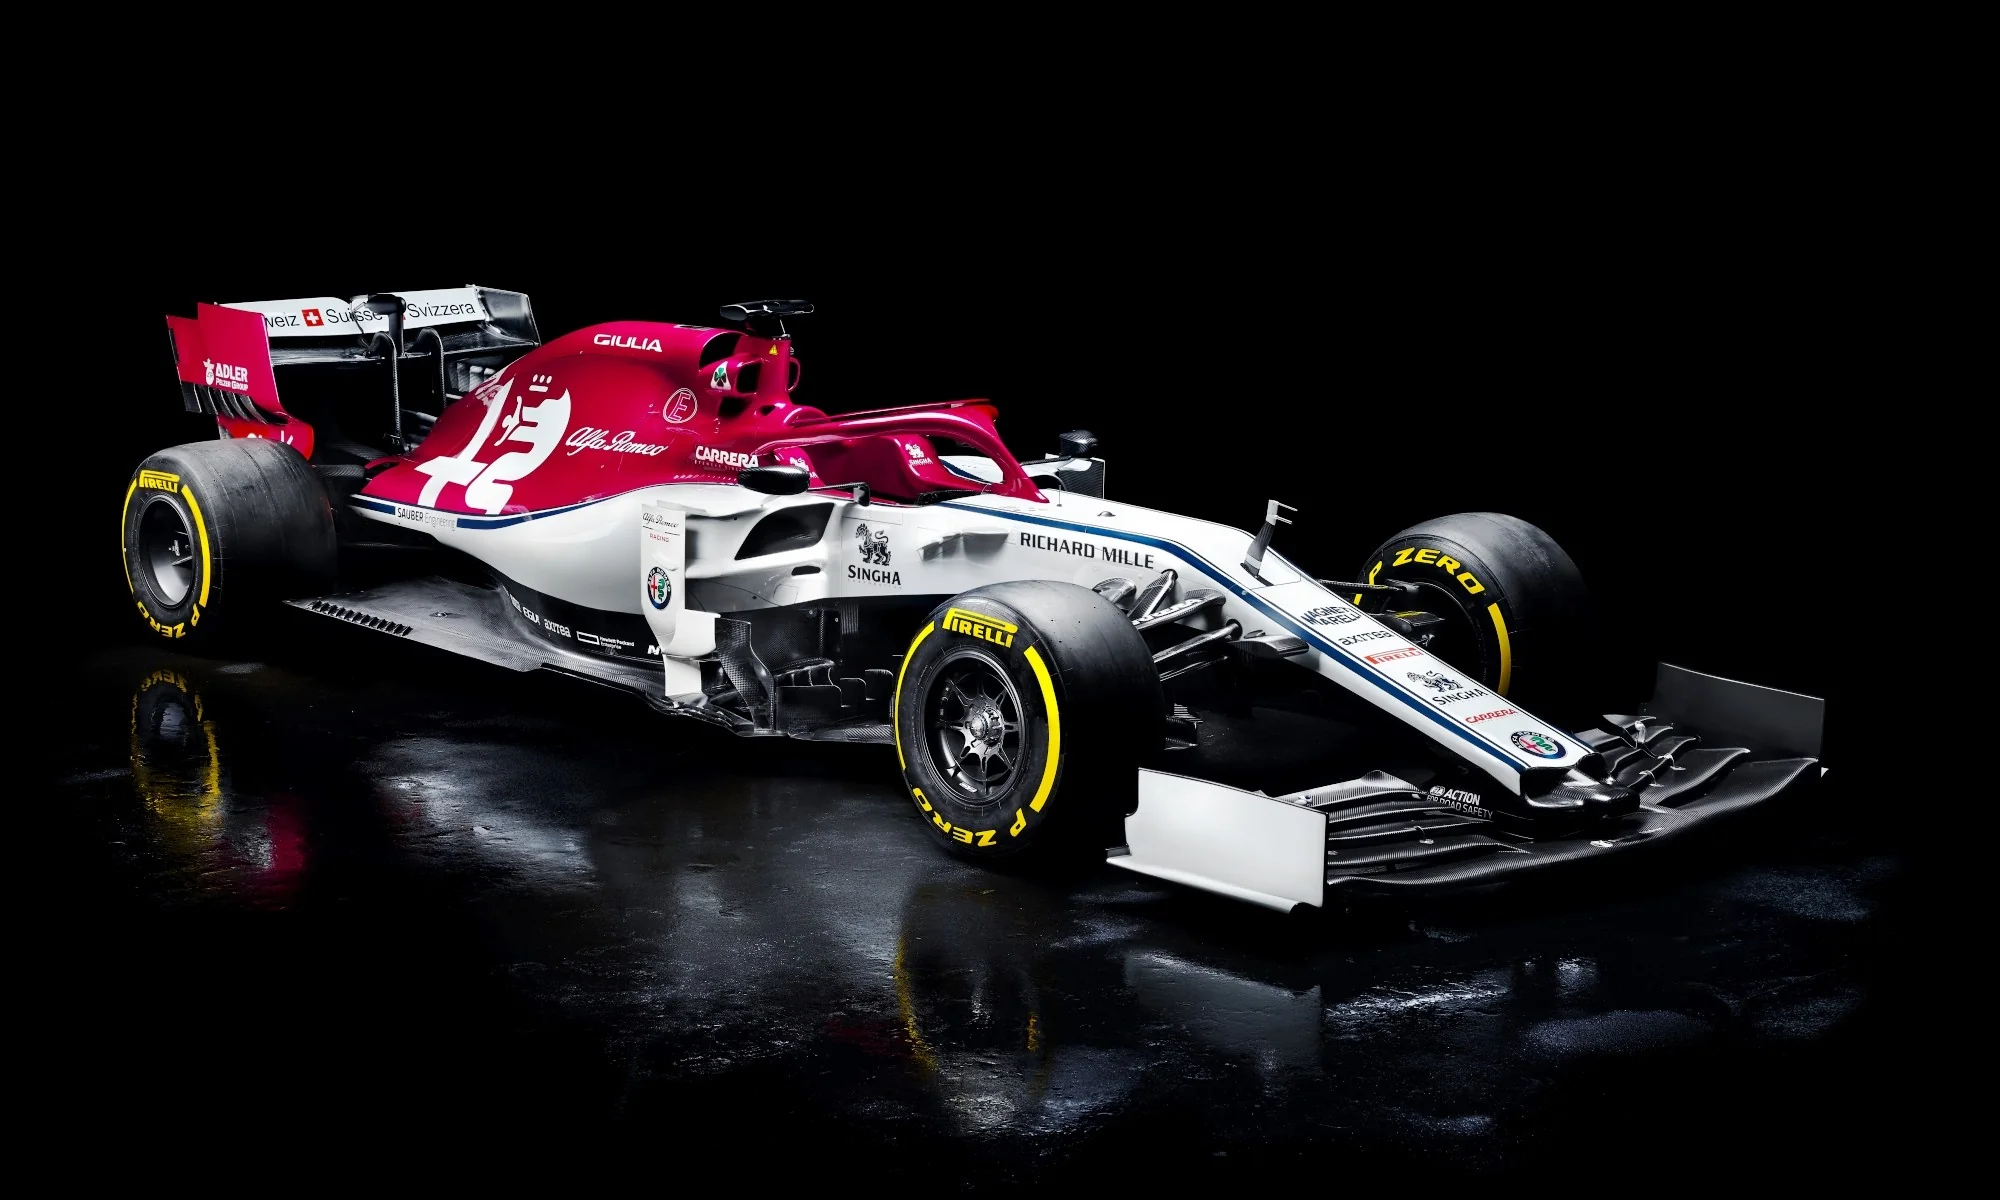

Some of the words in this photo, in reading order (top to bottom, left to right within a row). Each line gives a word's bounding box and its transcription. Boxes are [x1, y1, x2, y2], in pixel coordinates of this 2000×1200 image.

[406, 301, 476, 319] Svizzera
[594, 333, 662, 352] GIULIA
[215, 362, 248, 382] ADLER
[565, 427, 609, 456] Alfa
[604, 430, 668, 456] Romeo
[696, 445, 759, 468] CARRERA
[138, 469, 180, 493] PIRELLI
[397, 507, 424, 522] SAUBER
[1020, 532, 1095, 558] RICHARD
[1102, 546, 1155, 569] MILLE
[848, 564, 901, 585] SINGHA
[1392, 547, 1486, 594] ZERO
[137, 601, 186, 638] ZERO
[191, 603, 200, 627] P
[941, 607, 1018, 649] PIRELLI
[1364, 647, 1424, 664] PIRELLI
[1432, 688, 1488, 705] SINGHA
[1465, 708, 1518, 723] CARRERA
[1443, 788, 1480, 806] ACTION
[913, 787, 997, 847] ZERO
[1009, 808, 1026, 837] P
[1462, 803, 1494, 820] SAFETY
